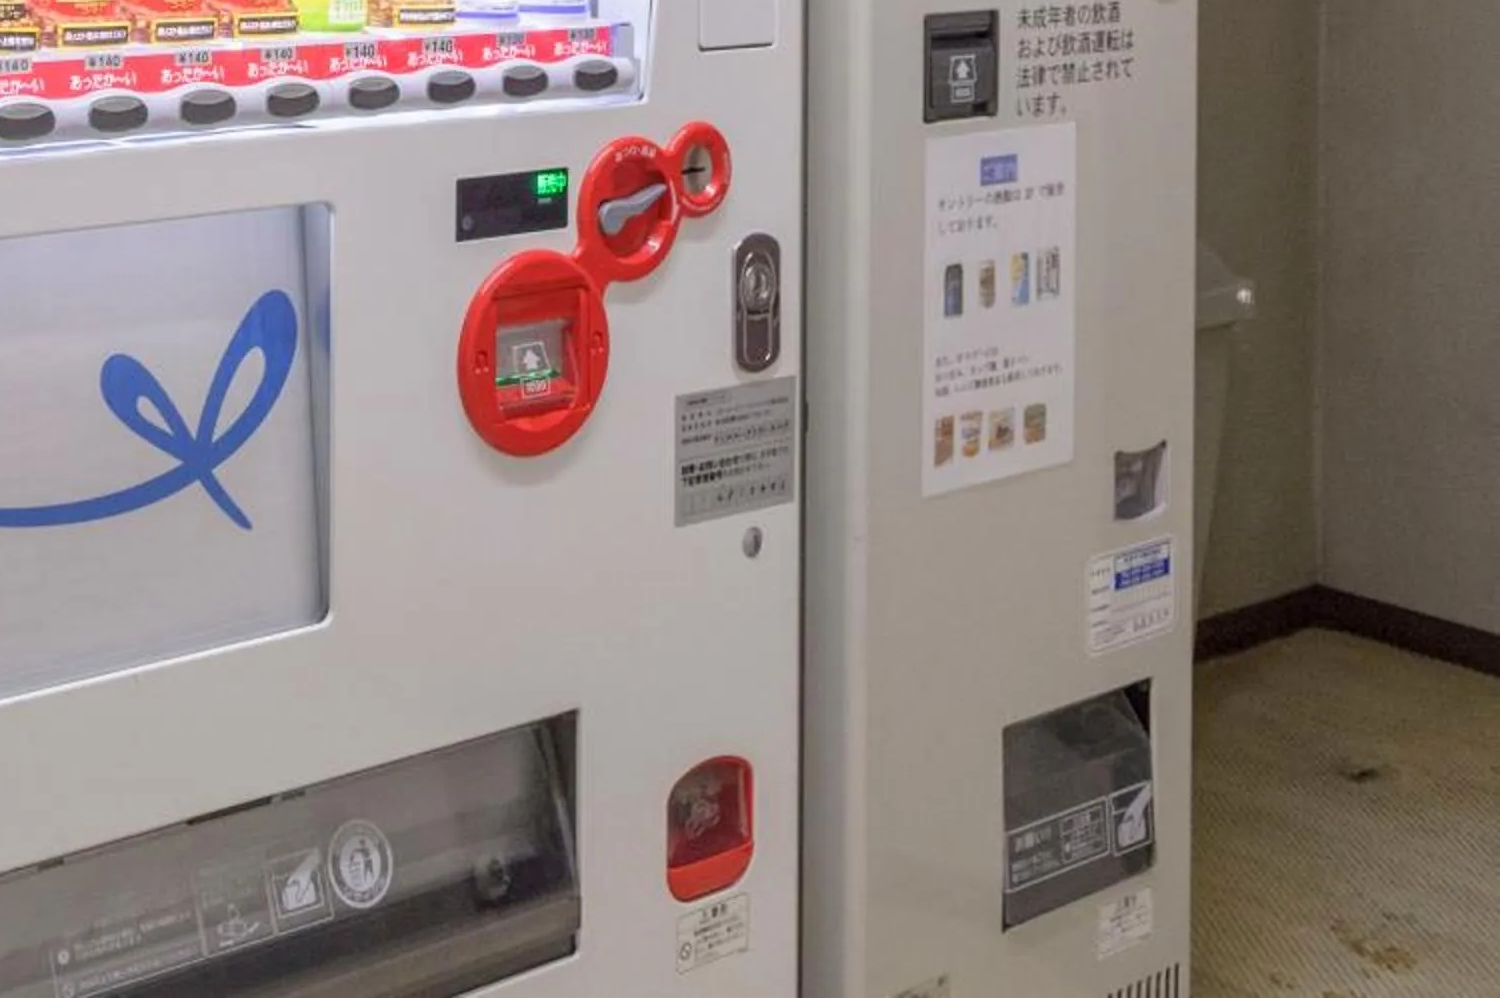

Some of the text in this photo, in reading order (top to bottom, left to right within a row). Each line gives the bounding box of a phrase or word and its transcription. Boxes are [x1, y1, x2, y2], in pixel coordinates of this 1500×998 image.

[1017, 2, 1121, 28] 未成年者の飲酒
[1018, 30, 1135, 59] および飲酒運転は
[1016, 58, 1135, 89] 法律で禁止されて
